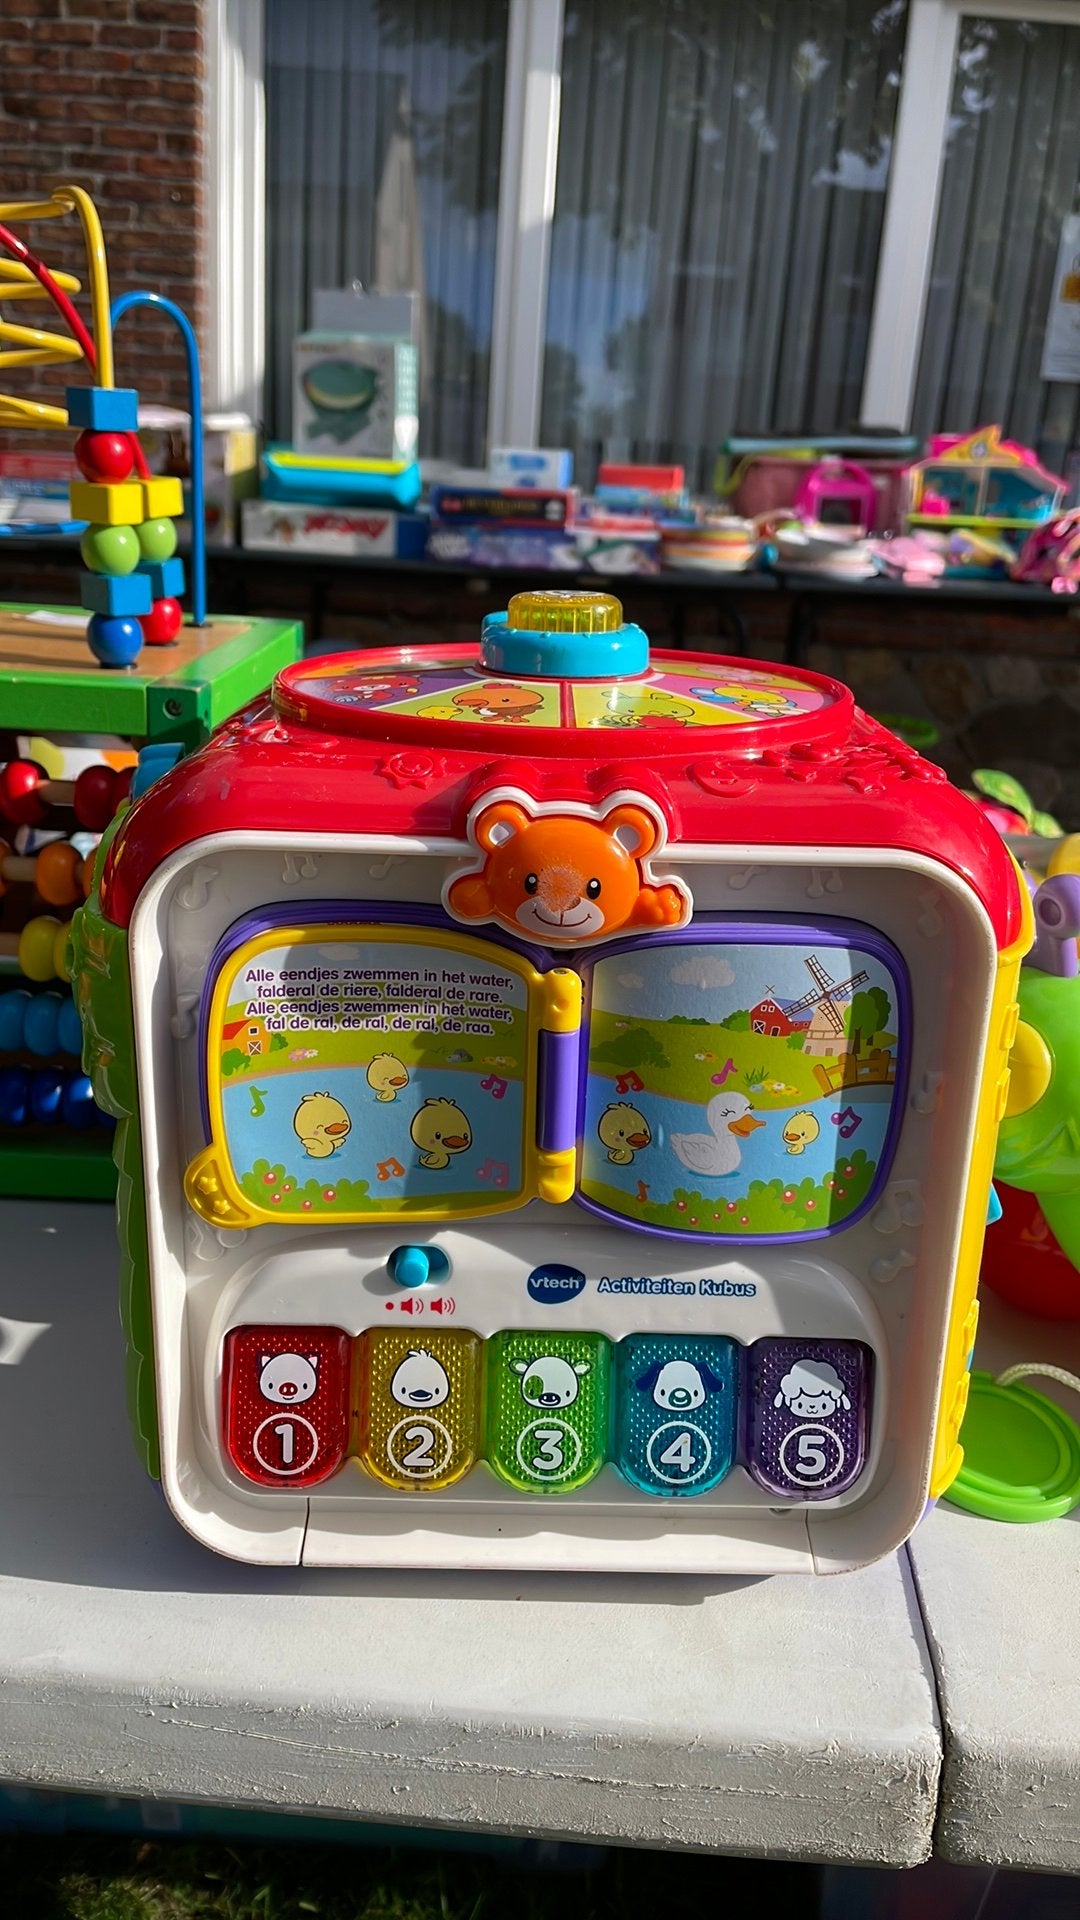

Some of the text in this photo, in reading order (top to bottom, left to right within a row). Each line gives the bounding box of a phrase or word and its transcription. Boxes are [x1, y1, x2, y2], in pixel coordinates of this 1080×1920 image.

[246, 967, 513, 990] Alle eendjes zwemmen in het water,
[257, 984, 503, 1003] falderal de riere, falderal de rare.
[247, 1000, 513, 1022] Alle eendjes zwemmen in het water,
[266, 1016, 493, 1034] fal de ral, de ral, de ral, de raa.
[530, 1275, 580, 1289] vtech
[598, 1277, 756, 1296] Activiteiten Kubus
[274, 1423, 294, 1464] 1
[402, 1425, 435, 1468] 2
[531, 1429, 564, 1470] 3
[660, 1431, 696, 1473] 4
[795, 1434, 827, 1475] 5
